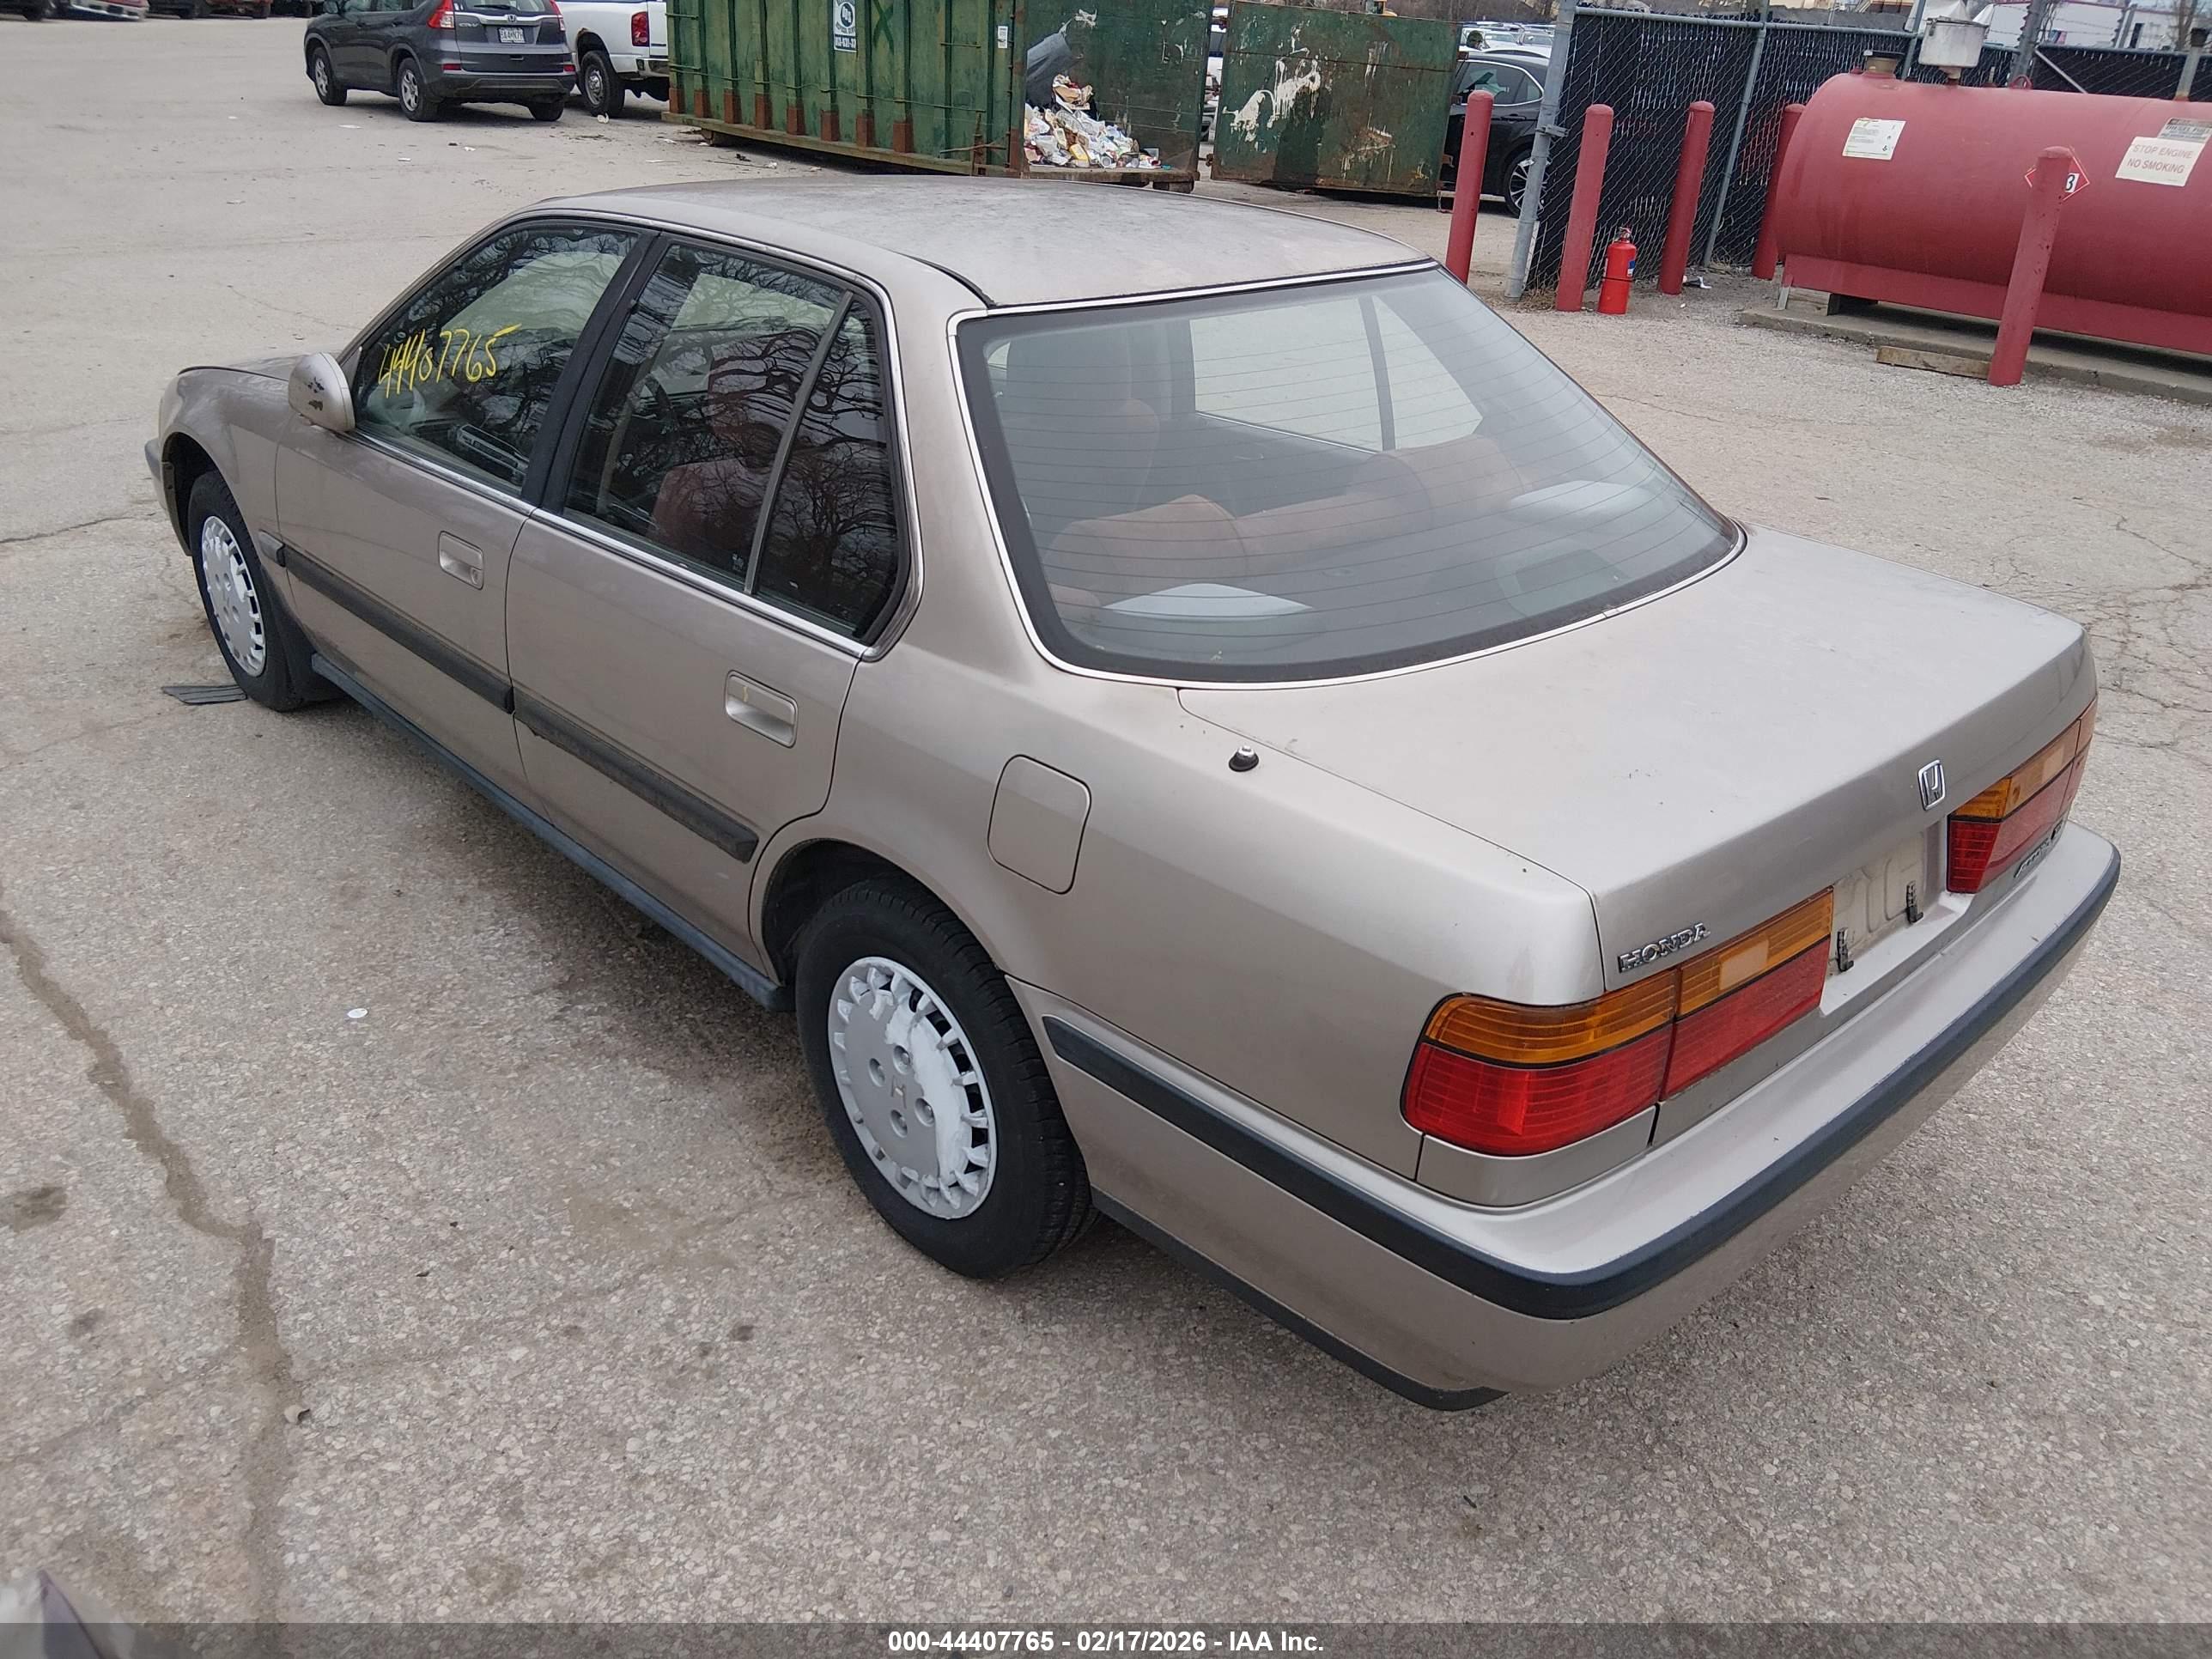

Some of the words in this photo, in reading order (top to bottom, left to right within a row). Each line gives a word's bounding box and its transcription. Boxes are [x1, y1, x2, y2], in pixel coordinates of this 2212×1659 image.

[2132, 144, 2158, 154] STOP
[2158, 148, 2194, 159] ENGINE
[2127, 158, 2142, 168] NO
[2142, 160, 2185, 173] SMOKING
[2064, 173, 2075, 191] 3
[378, 323, 522, 398] 44407765
[1617, 922, 1711, 973] HONDA
